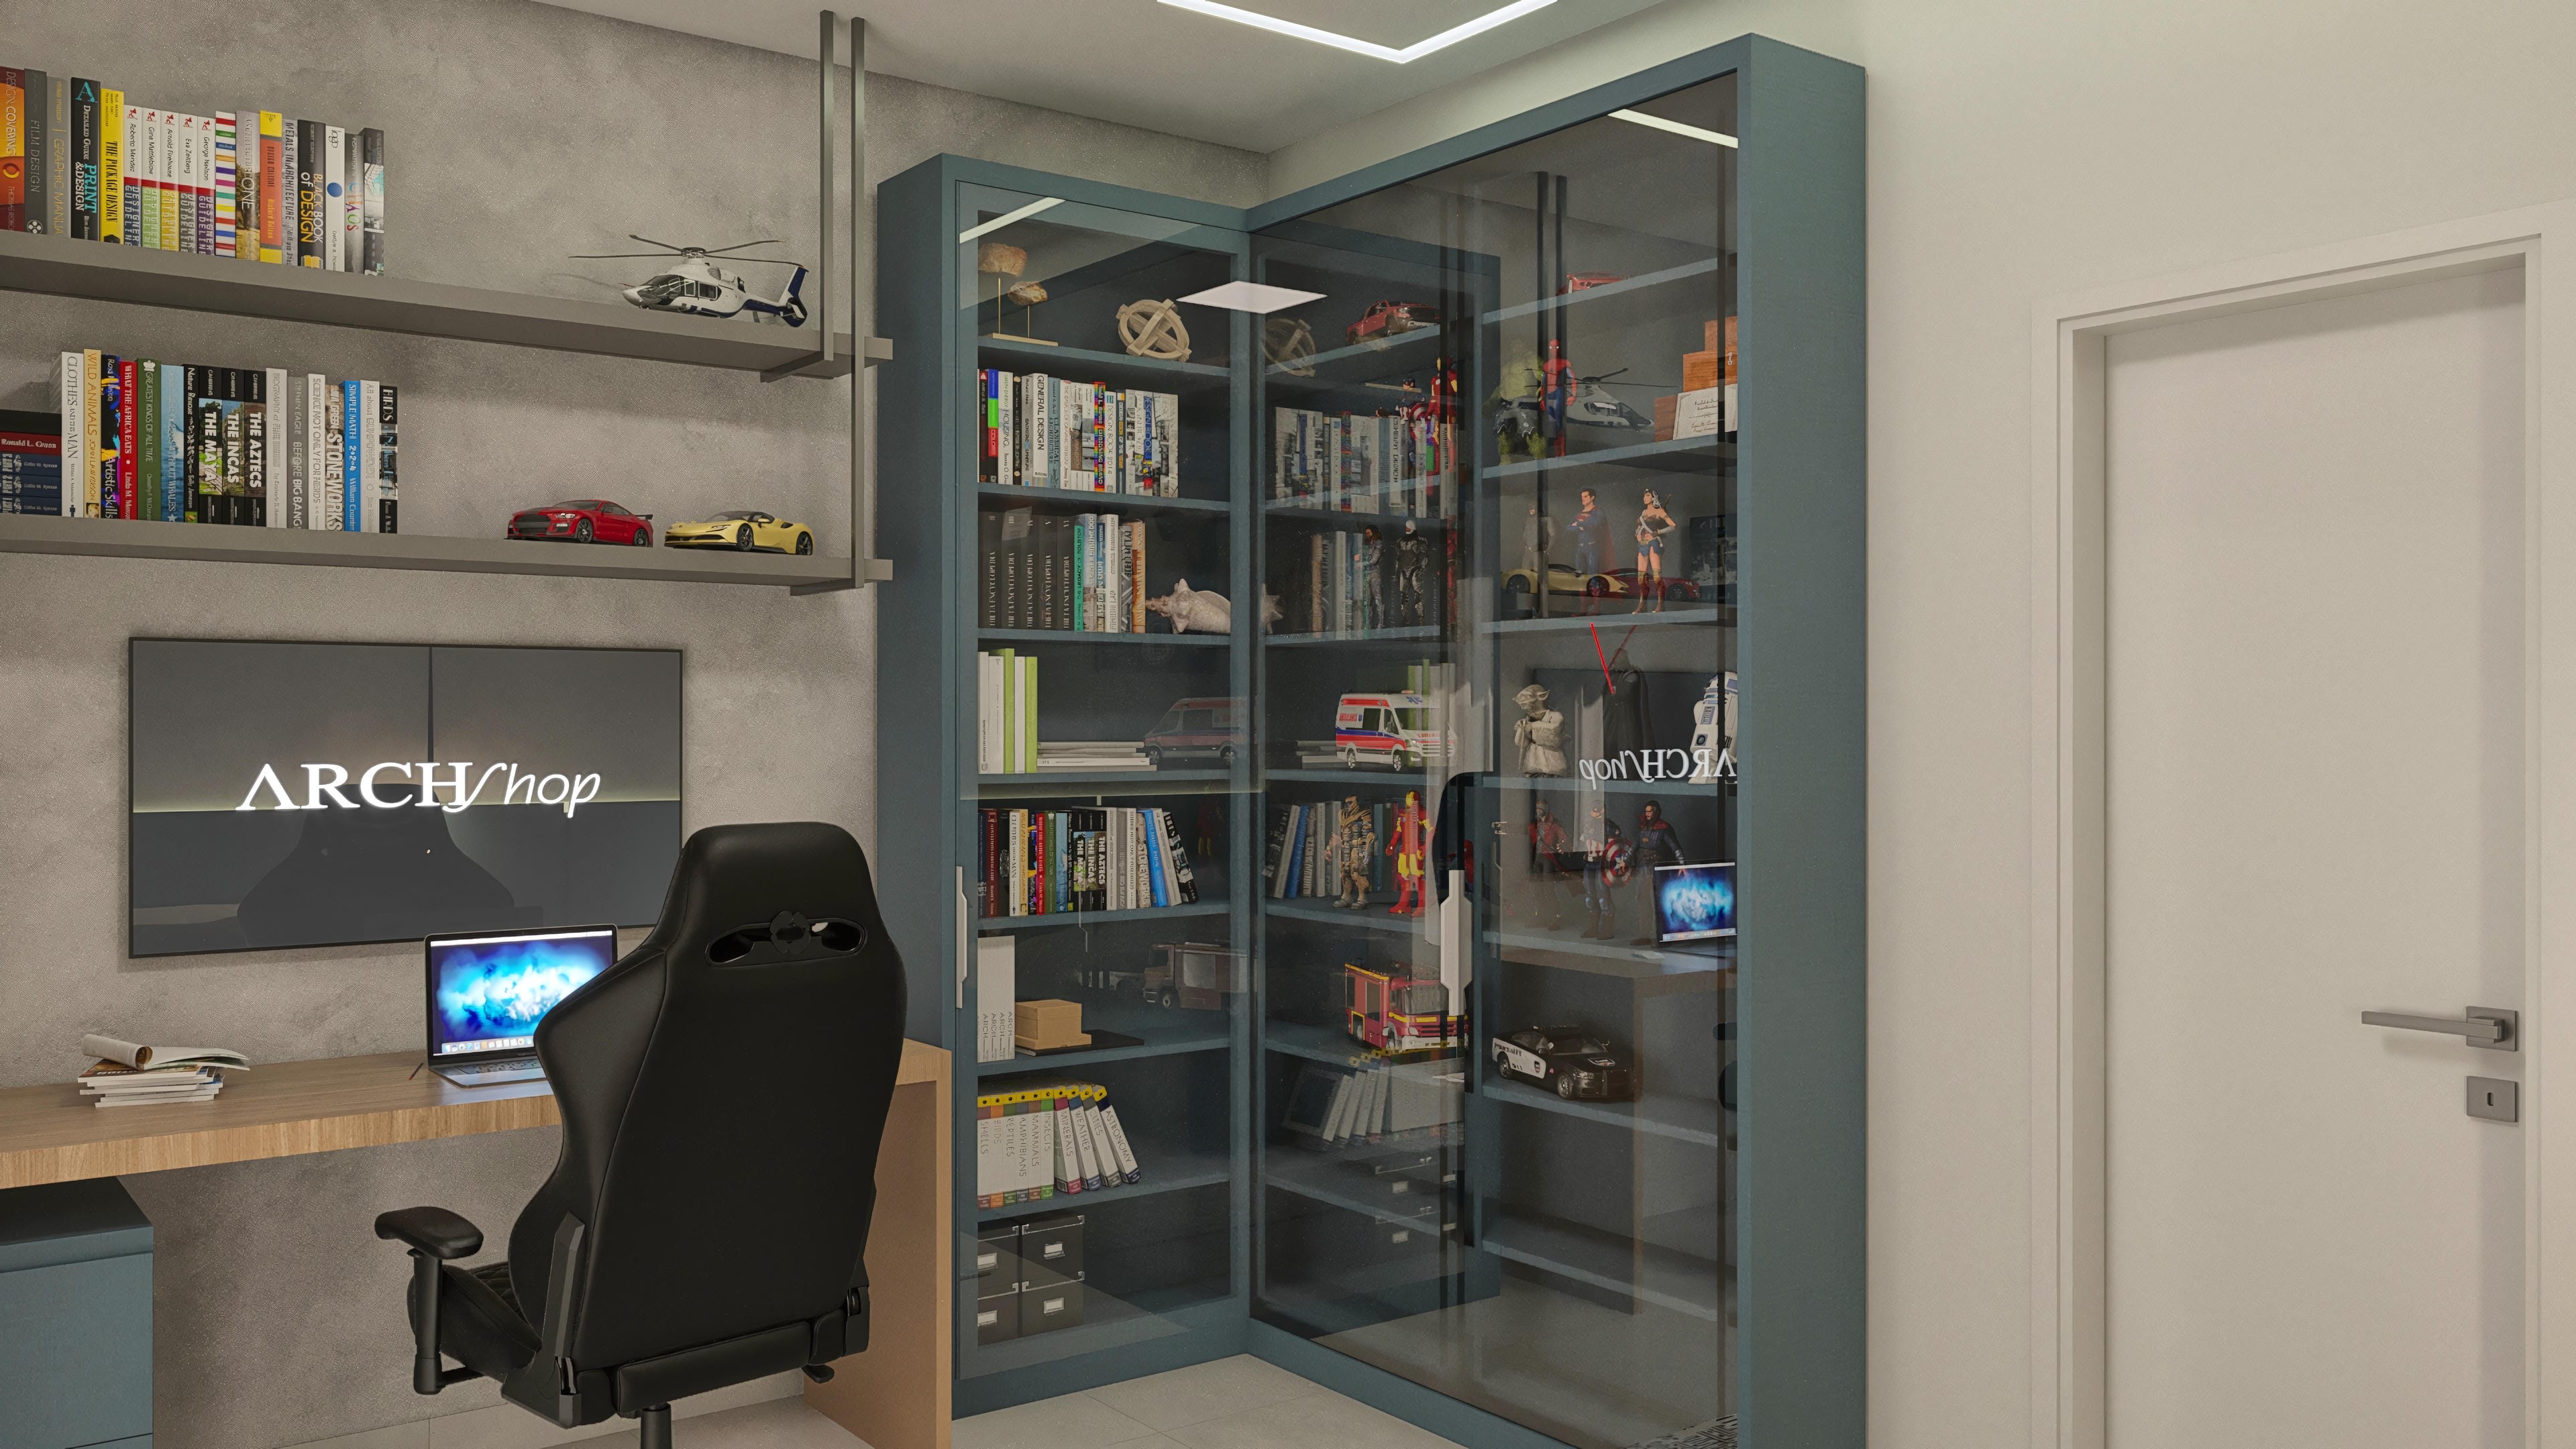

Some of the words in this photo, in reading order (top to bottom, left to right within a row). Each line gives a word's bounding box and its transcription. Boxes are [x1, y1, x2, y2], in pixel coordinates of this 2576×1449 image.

[6, 71, 16, 105] DESIGN
[30, 119, 40, 145] FILM
[105, 141, 118, 157] THE
[285, 122, 294, 151] METALS
[329, 129, 342, 148] logo
[30, 149, 40, 193] DESIGN
[53, 138, 65, 189] GRAPHIC
[105, 158, 118, 193] PACKAGE
[301, 172, 313, 188] of
[75, 162, 85, 212] &DESIGN
[84, 163, 97, 213] PRINT
[285, 164, 294, 220] ARCHITECTURE
[313, 173, 323, 207] BLACK
[105, 193, 118, 223] DESIGN
[132, 186, 140, 242] DESIGNER
[206, 197, 215, 250] DESIGNER
[301, 190, 313, 243] DESIGN
[345, 182, 362, 231] CHAOS
[313, 211, 323, 244] BOOK
[67, 356, 78, 405] CLOTHES
[87, 352, 97, 380] WILD
[87, 382, 97, 435] ANIMALS
[205, 411, 217, 437] THE
[227, 413, 239, 439] THE
[250, 412, 262, 436] THE
[313, 411, 321, 429] NOT
[67, 432, 78, 459] MAN
[146, 424, 153, 433] OF
[105, 458, 116, 492] Artistic
[205, 439, 217, 482] MAYA
[227, 441, 239, 483] INCAS
[250, 439, 262, 488] AZTECS
[292, 441, 302, 477] BEFORE
[168, 480, 176, 512] WHALES
[292, 478, 302, 495] BIG
[326, 433, 343, 531] STONEWORKS
[104, 494, 116, 519] Skills
[1006, 1118, 1015, 1157] REPTILES
[1044, 1113, 1052, 1152] INSECTS
[1060, 1111, 1073, 1157] MINERALS
[1075, 1110, 1091, 1152] WEATHER
[1089, 1109, 1104, 1136] CITIES
[1104, 1110, 1132, 1163] ASTRONOMY
[1019, 1117, 1027, 1177] AMPHIBIANS
[1032, 1115, 1040, 1167] MAMMALS
